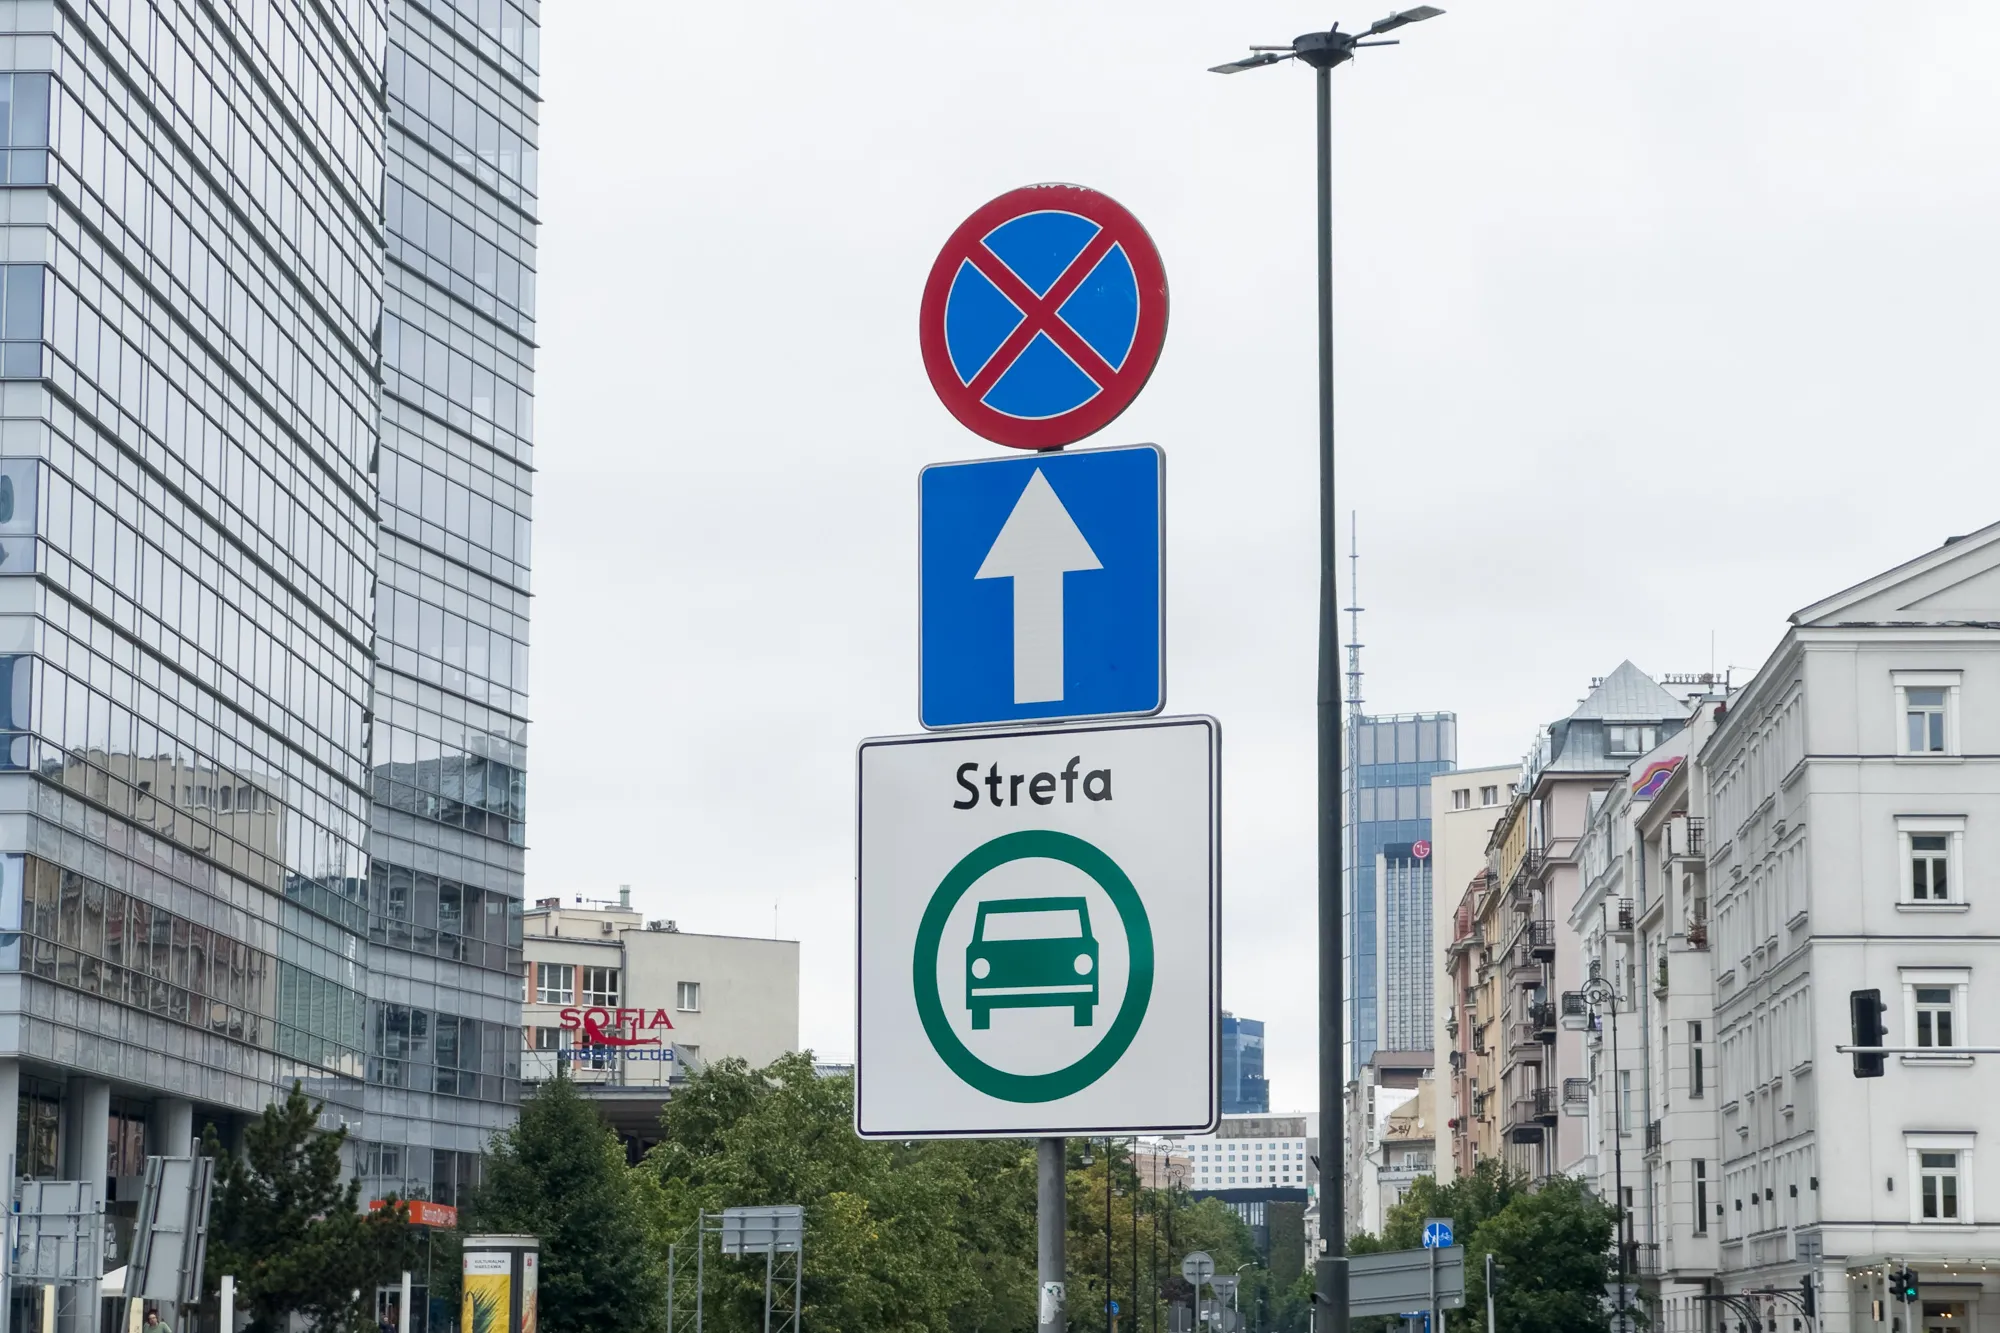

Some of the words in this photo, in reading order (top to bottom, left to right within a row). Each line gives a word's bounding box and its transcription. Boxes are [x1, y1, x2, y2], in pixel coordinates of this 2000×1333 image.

[953, 755, 1113, 810] Strefa
[560, 1008, 675, 1029] SOFIA
[561, 1049, 615, 1061] NIGHT
[626, 1049, 674, 1061] CLUB
